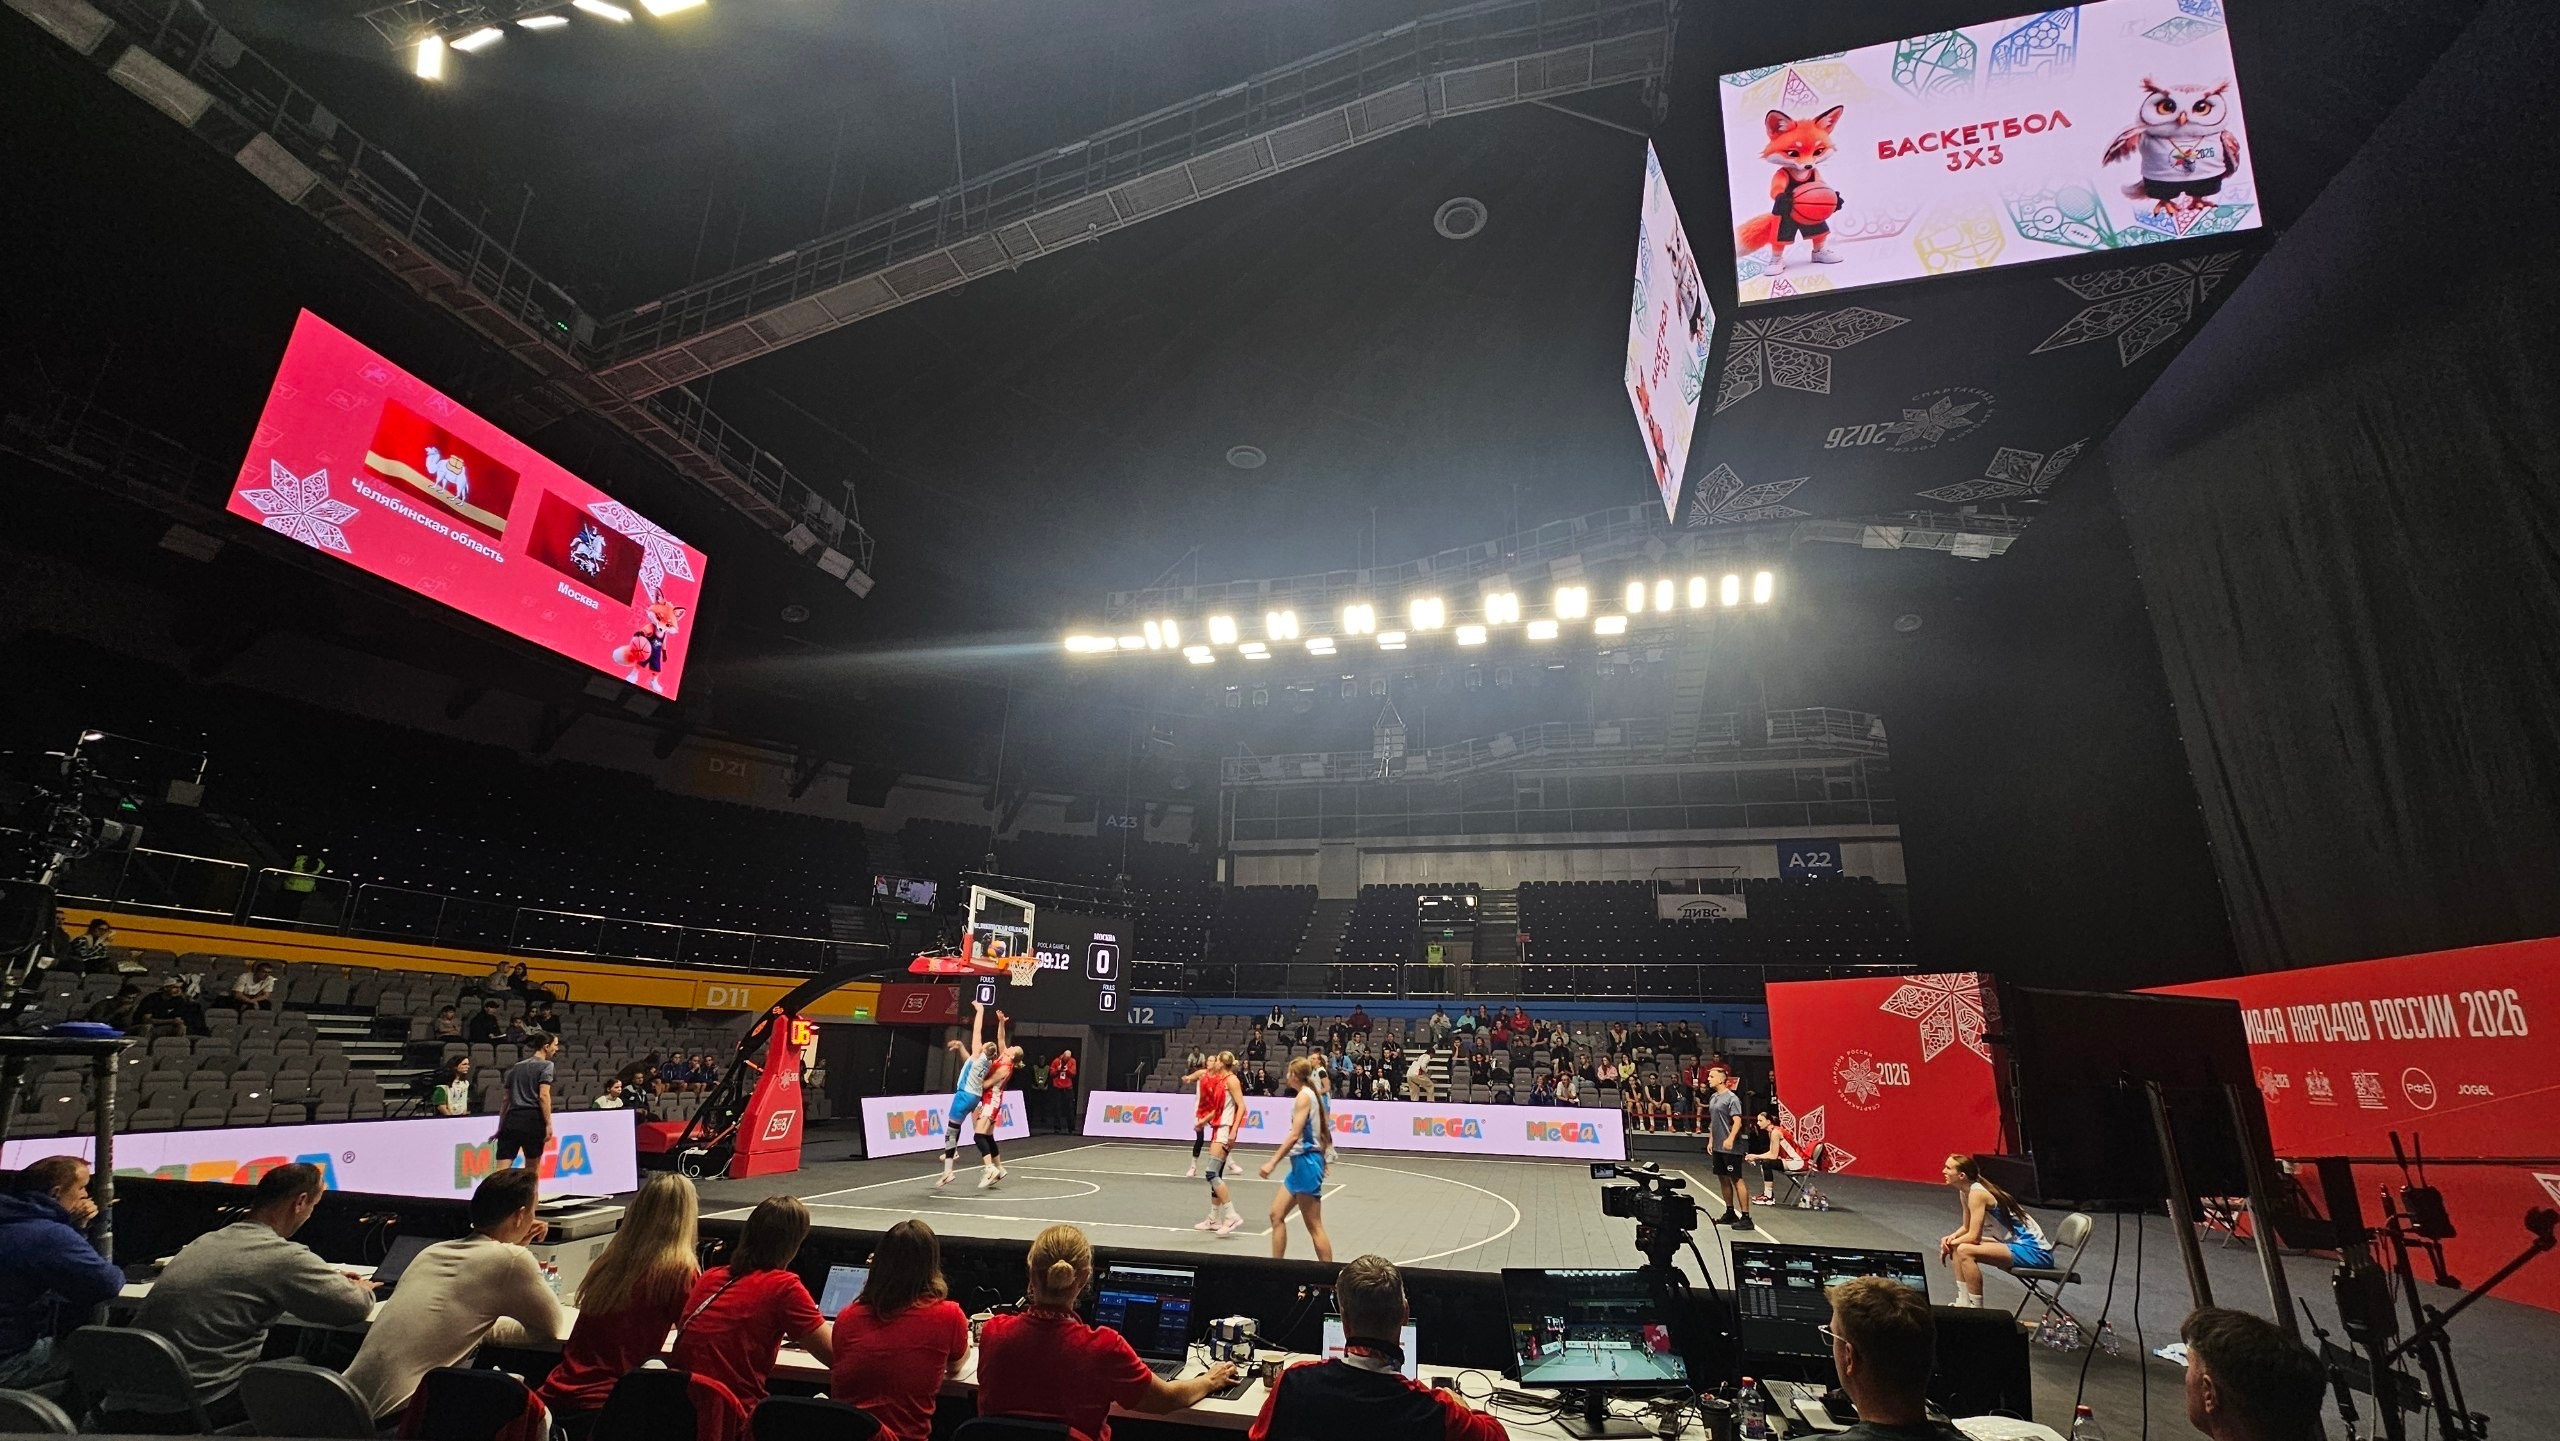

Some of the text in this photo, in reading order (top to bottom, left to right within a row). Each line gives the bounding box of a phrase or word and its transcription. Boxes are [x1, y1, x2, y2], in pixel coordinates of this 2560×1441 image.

[1877, 109, 2073, 160] БАСКЕТБОЛ
[1824, 421, 1896, 449] 2026
[351, 477, 505, 564] Челябинская область
[557, 581, 600, 610] Москва
[708, 757, 746, 777] D21
[1105, 814, 1138, 829] A23
[1789, 852, 1832, 867] A22
[1682, 908, 1720, 918] ДИВС
[1093, 932, 1115, 942] МОСКВА
[1096, 949, 1110, 974] 0
[980, 975, 994, 984] FOULS
[1102, 983, 1116, 991] FOULS
[706, 986, 750, 1008] D11
[981, 987, 990, 1002] 0
[1104, 994, 1112, 1008] 0
[2241, 988, 2529, 1044] ИАДА НАРОДОВ РОССИИ 2026
[1876, 1062, 1911, 1086] 2026
[2406, 1083, 2432, 1094] РФБ
